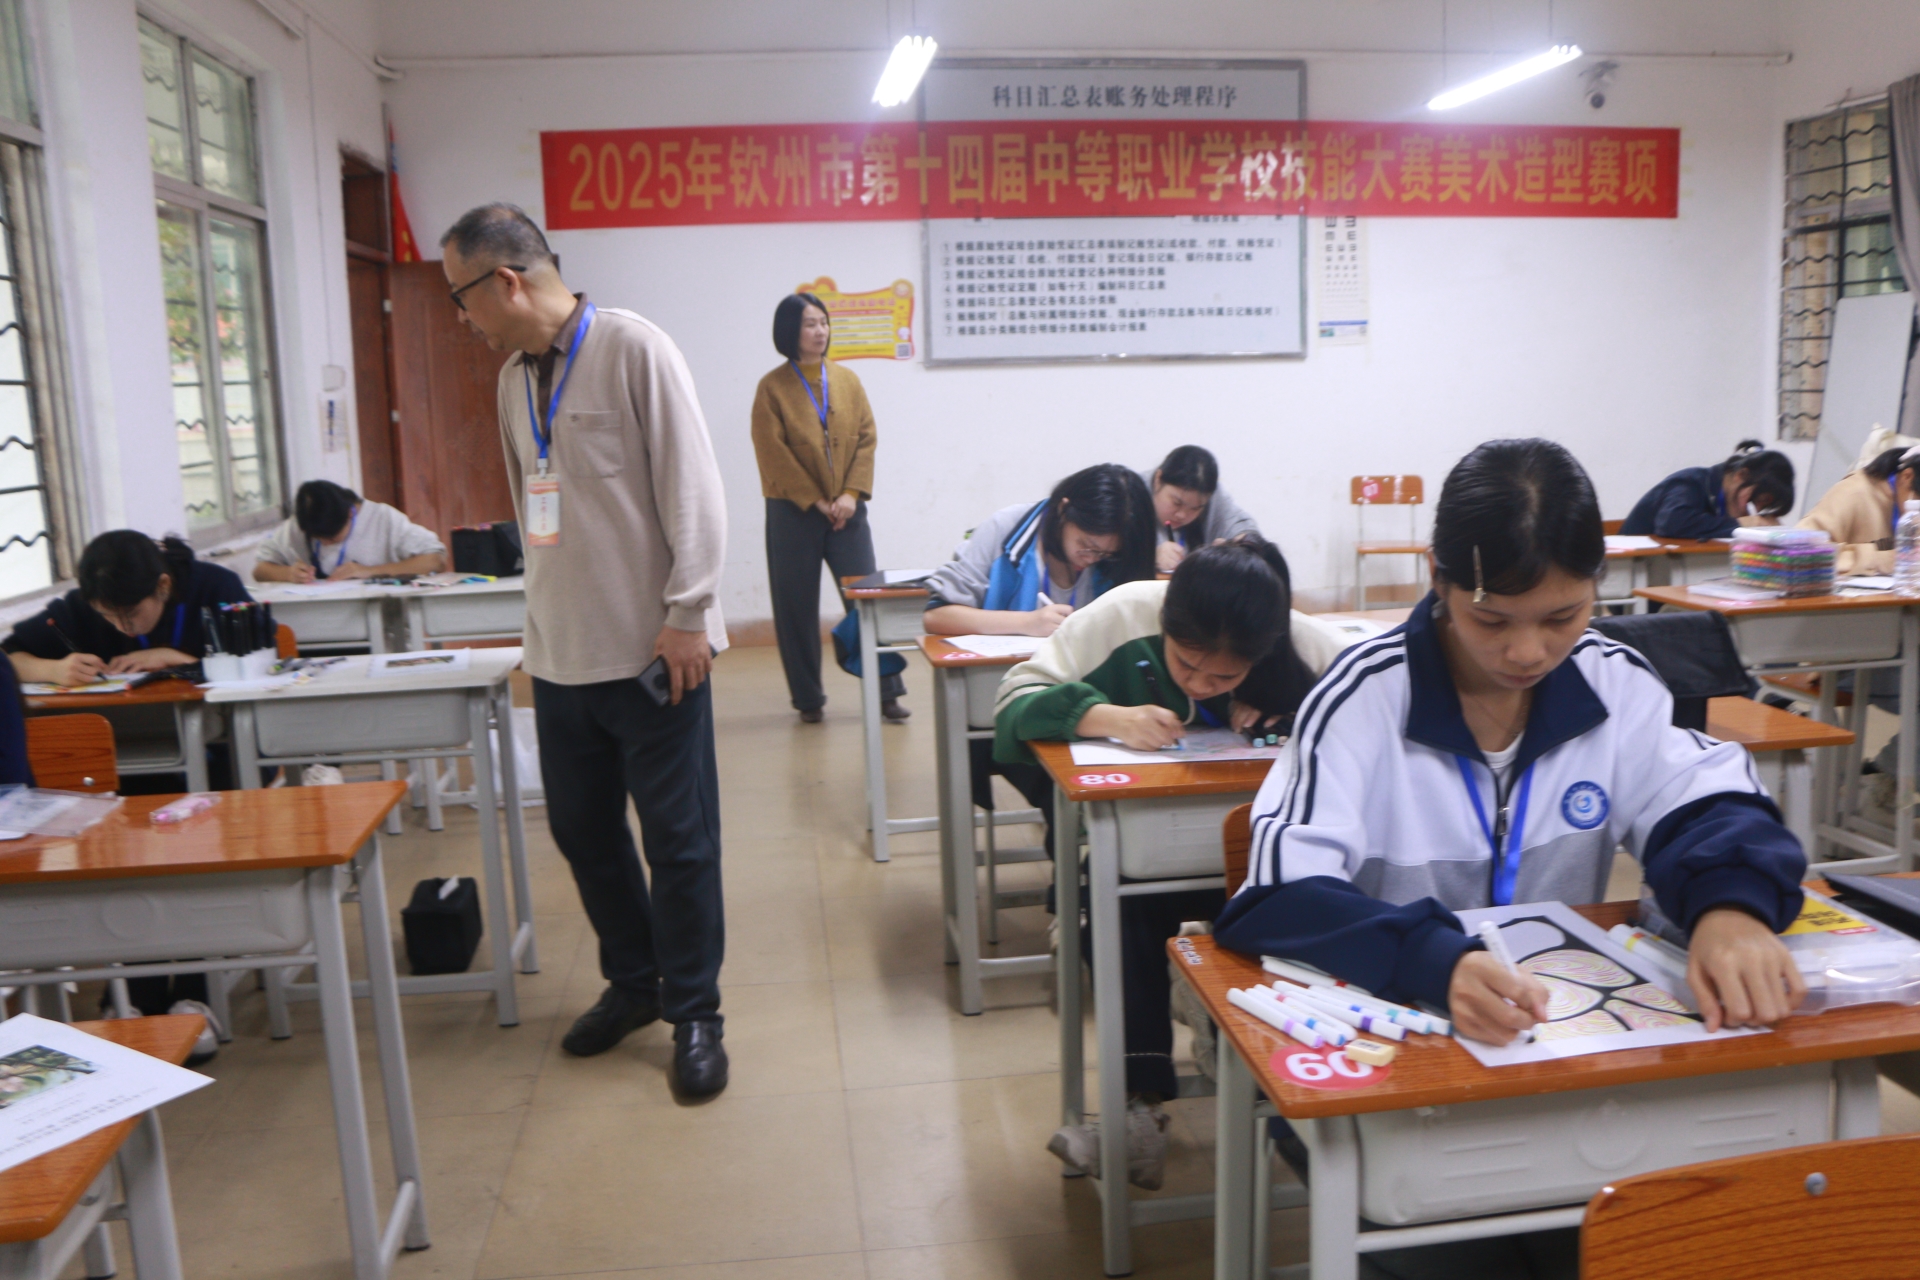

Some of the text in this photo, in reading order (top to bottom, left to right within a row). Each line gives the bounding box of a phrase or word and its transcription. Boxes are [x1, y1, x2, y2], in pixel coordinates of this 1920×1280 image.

[992, 84, 1238, 109] 科目汇总表账务处理程序
[568, 129, 1658, 212] 2025年钦州市第十四届中等职业学校技能大赛美术造型赛项
